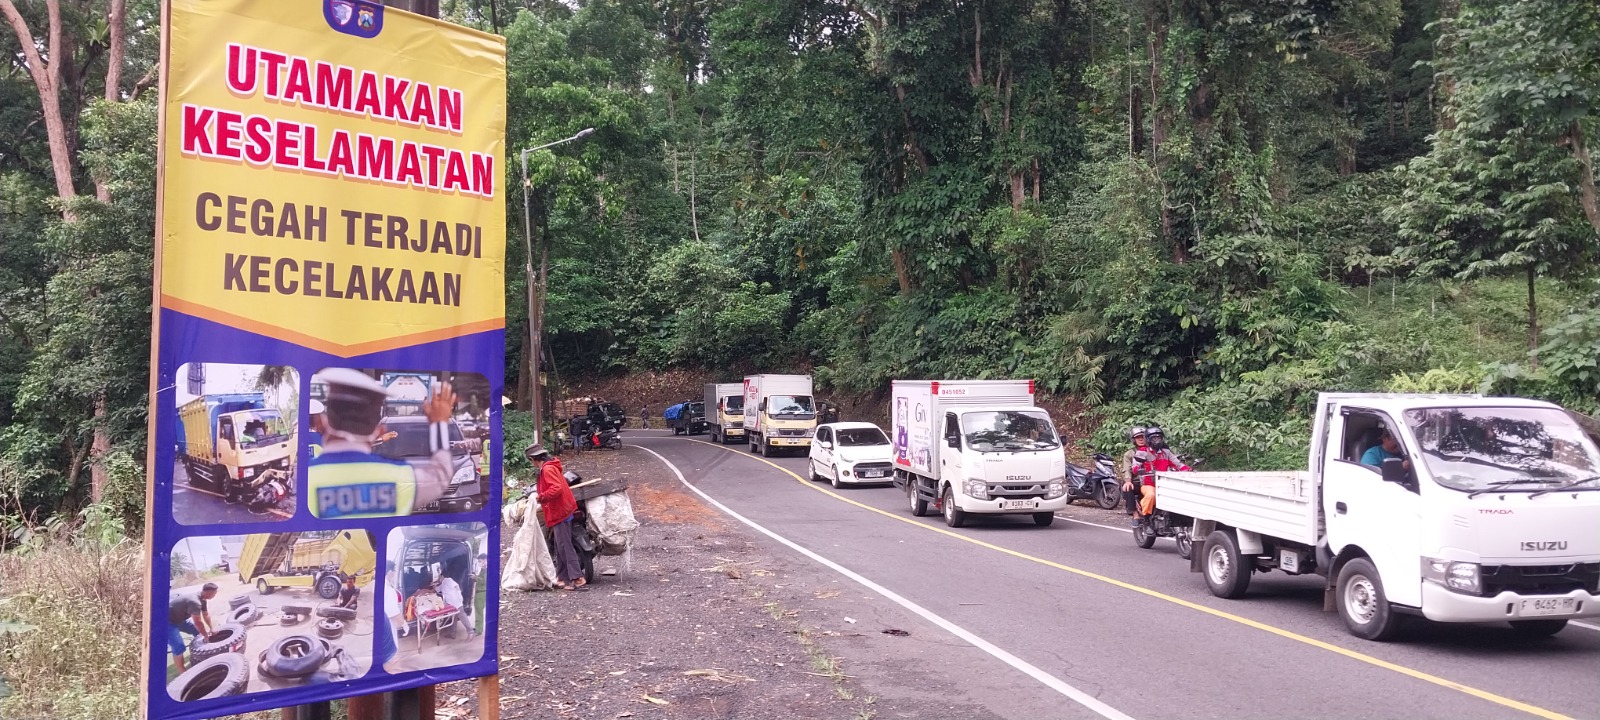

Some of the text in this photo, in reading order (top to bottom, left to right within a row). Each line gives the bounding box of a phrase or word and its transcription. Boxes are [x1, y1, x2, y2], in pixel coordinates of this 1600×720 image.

[227, 43, 463, 133] UTAMAKAN
[182, 104, 495, 197] KESELAMATAN
[195, 192, 482, 259] CEGAH TERJADI
[223, 253, 462, 307] KECELAKAAN
[1520, 540, 1568, 551] ISUZU
